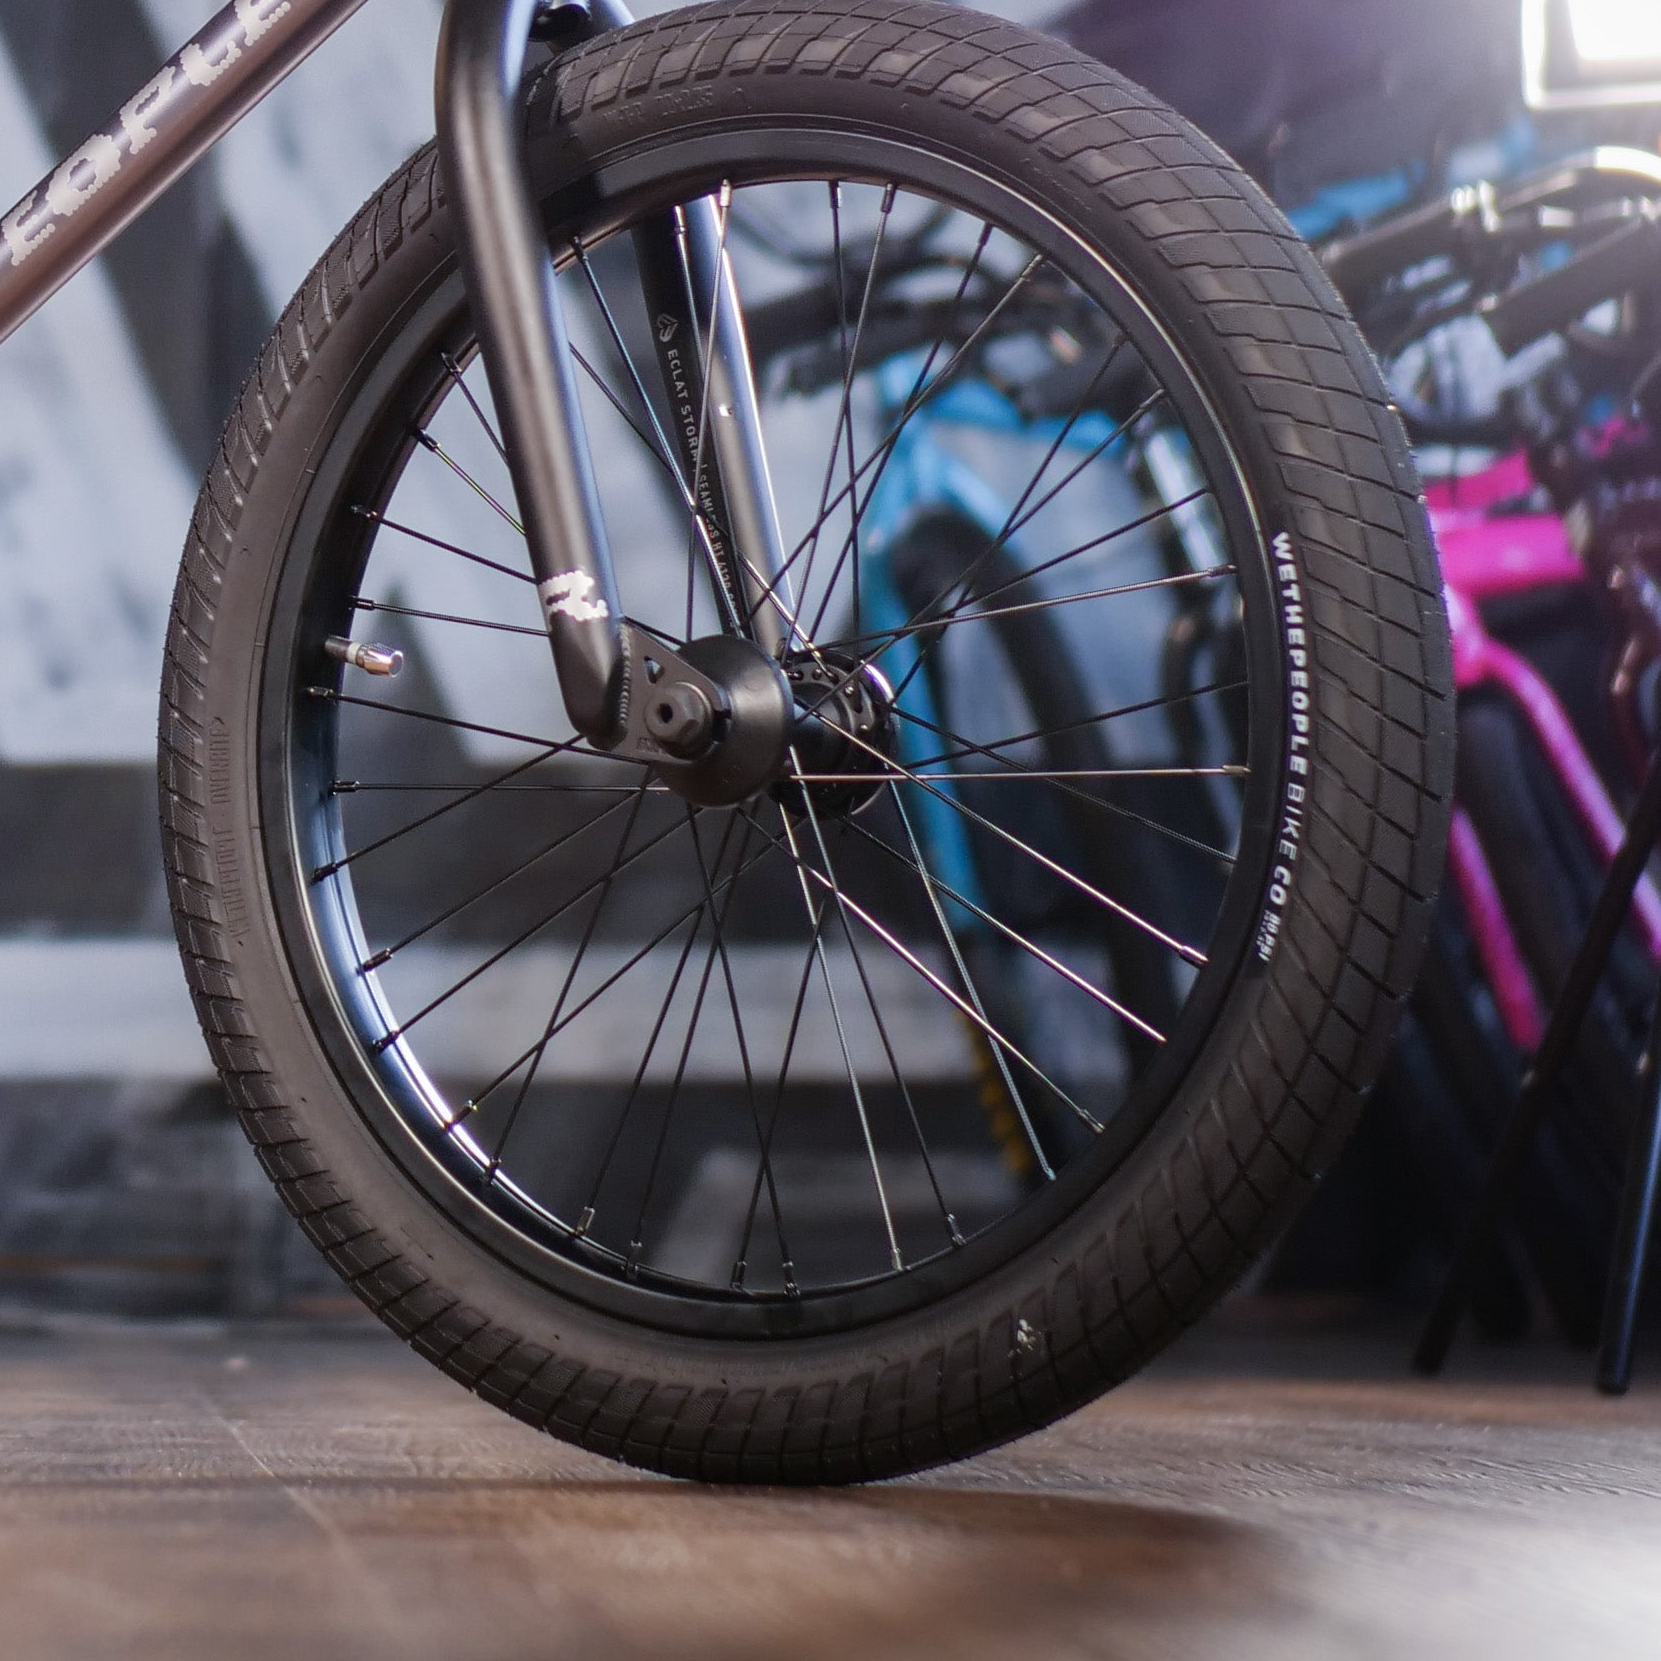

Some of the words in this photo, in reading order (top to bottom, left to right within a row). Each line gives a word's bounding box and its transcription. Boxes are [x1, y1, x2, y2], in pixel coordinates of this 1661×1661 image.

[667, 348, 689, 400] ECLAT
[1270, 531, 1313, 775] WETHEPEOPLE
[1280, 784, 1307, 861] BIKE
[1269, 864, 1292, 906] CO
